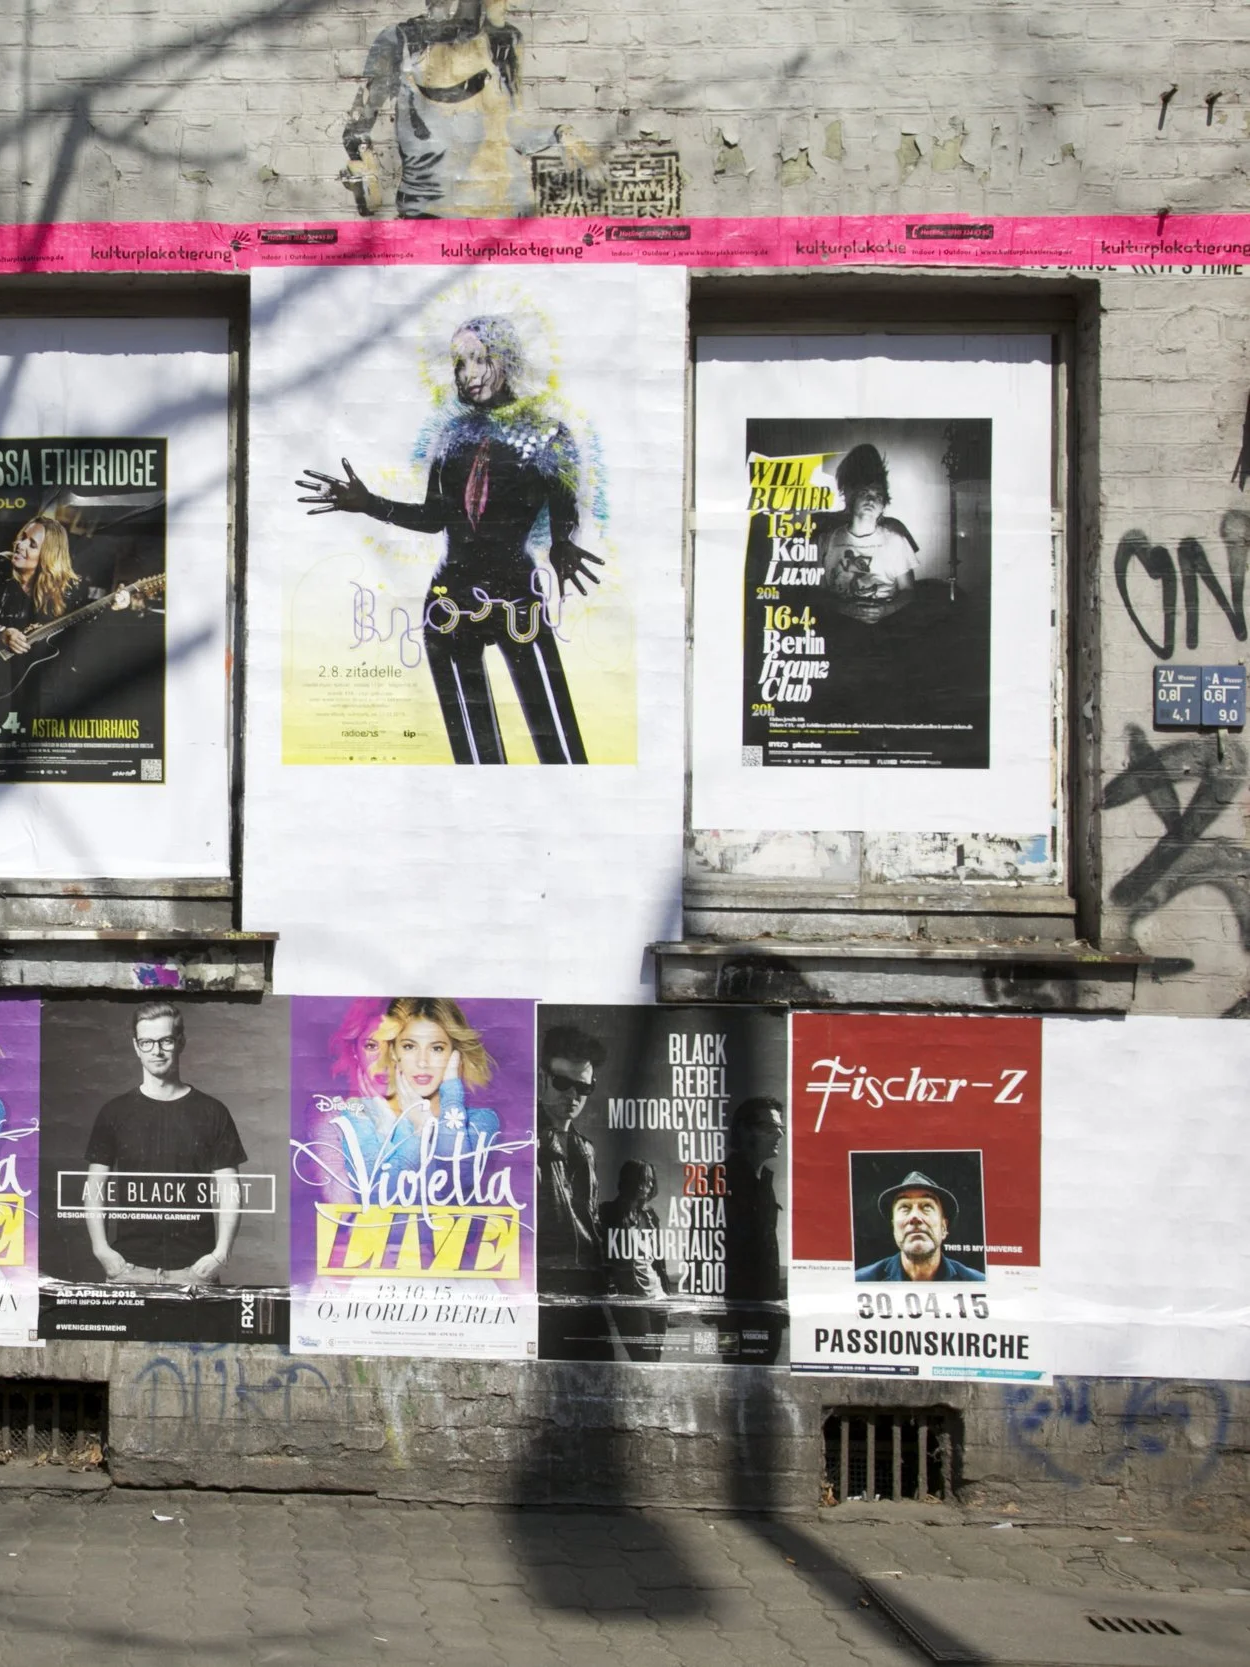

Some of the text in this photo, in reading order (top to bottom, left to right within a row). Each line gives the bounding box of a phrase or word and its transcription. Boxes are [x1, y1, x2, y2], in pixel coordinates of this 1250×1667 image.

[91, 244, 232, 264] kulturplakatierung
[441, 243, 583, 261] kulturplakatierung
[41, 449, 158, 487] ETHERIDGE
[749, 461, 806, 486] WILL
[747, 486, 831, 511] BUTLER
[771, 537, 818, 562] Köln
[763, 560, 826, 586] Luxor
[756, 586, 780, 601] 20h
[763, 629, 826, 655] Berlin
[318, 664, 402, 678] 2.8. zitadelle
[1158, 670, 1175, 683] ZV
[1212, 672, 1220, 685] A
[761, 676, 812, 702] Club
[751, 703, 776, 717] 20h
[31, 719, 65, 738] ASTRA
[69, 719, 140, 739] KULTURHAUS
[403, 729, 416, 738] tip
[669, 1033, 727, 1065] BLACK
[672, 1066, 730, 1098] REBEL
[608, 1098, 729, 1130] MOTORCYCLE
[677, 1131, 725, 1163] CLUB
[290, 1099, 538, 1231] Violetta
[81, 1180, 253, 1205] AXE BLACK SHIRT
[683, 1163, 732, 1197] 26.6.
[57, 1211, 95, 1219] DESIGNED
[108, 1212, 163, 1221] JOKO/GERMAN
[164, 1213, 201, 1221] GARMENT
[668, 1196, 727, 1229] ASTRA
[322, 1211, 516, 1272] LIVE
[608, 1228, 726, 1261] KULTURHAUS
[963, 1244, 970, 1252] IS
[972, 1244, 984, 1252] MY
[985, 1245, 1023, 1253] UNIVERSE
[677, 1262, 726, 1294] 21:00
[56, 1298, 78, 1306] MEHR
[117, 1299, 145, 1307] AXE.DE
[76, 1290, 110, 1298] APRIL
[112, 1290, 137, 1299] 2015
[376, 1284, 453, 1300] 13.10.15
[241, 1290, 255, 1329] AXE
[345, 1301, 429, 1323] WORLD
[434, 1303, 520, 1325] BERLIN
[856, 1292, 990, 1320] 30.04.15
[56, 1323, 127, 1332] #WENIGERISTMEHR
[814, 1328, 1029, 1360] PASSIONSKIRCHE
